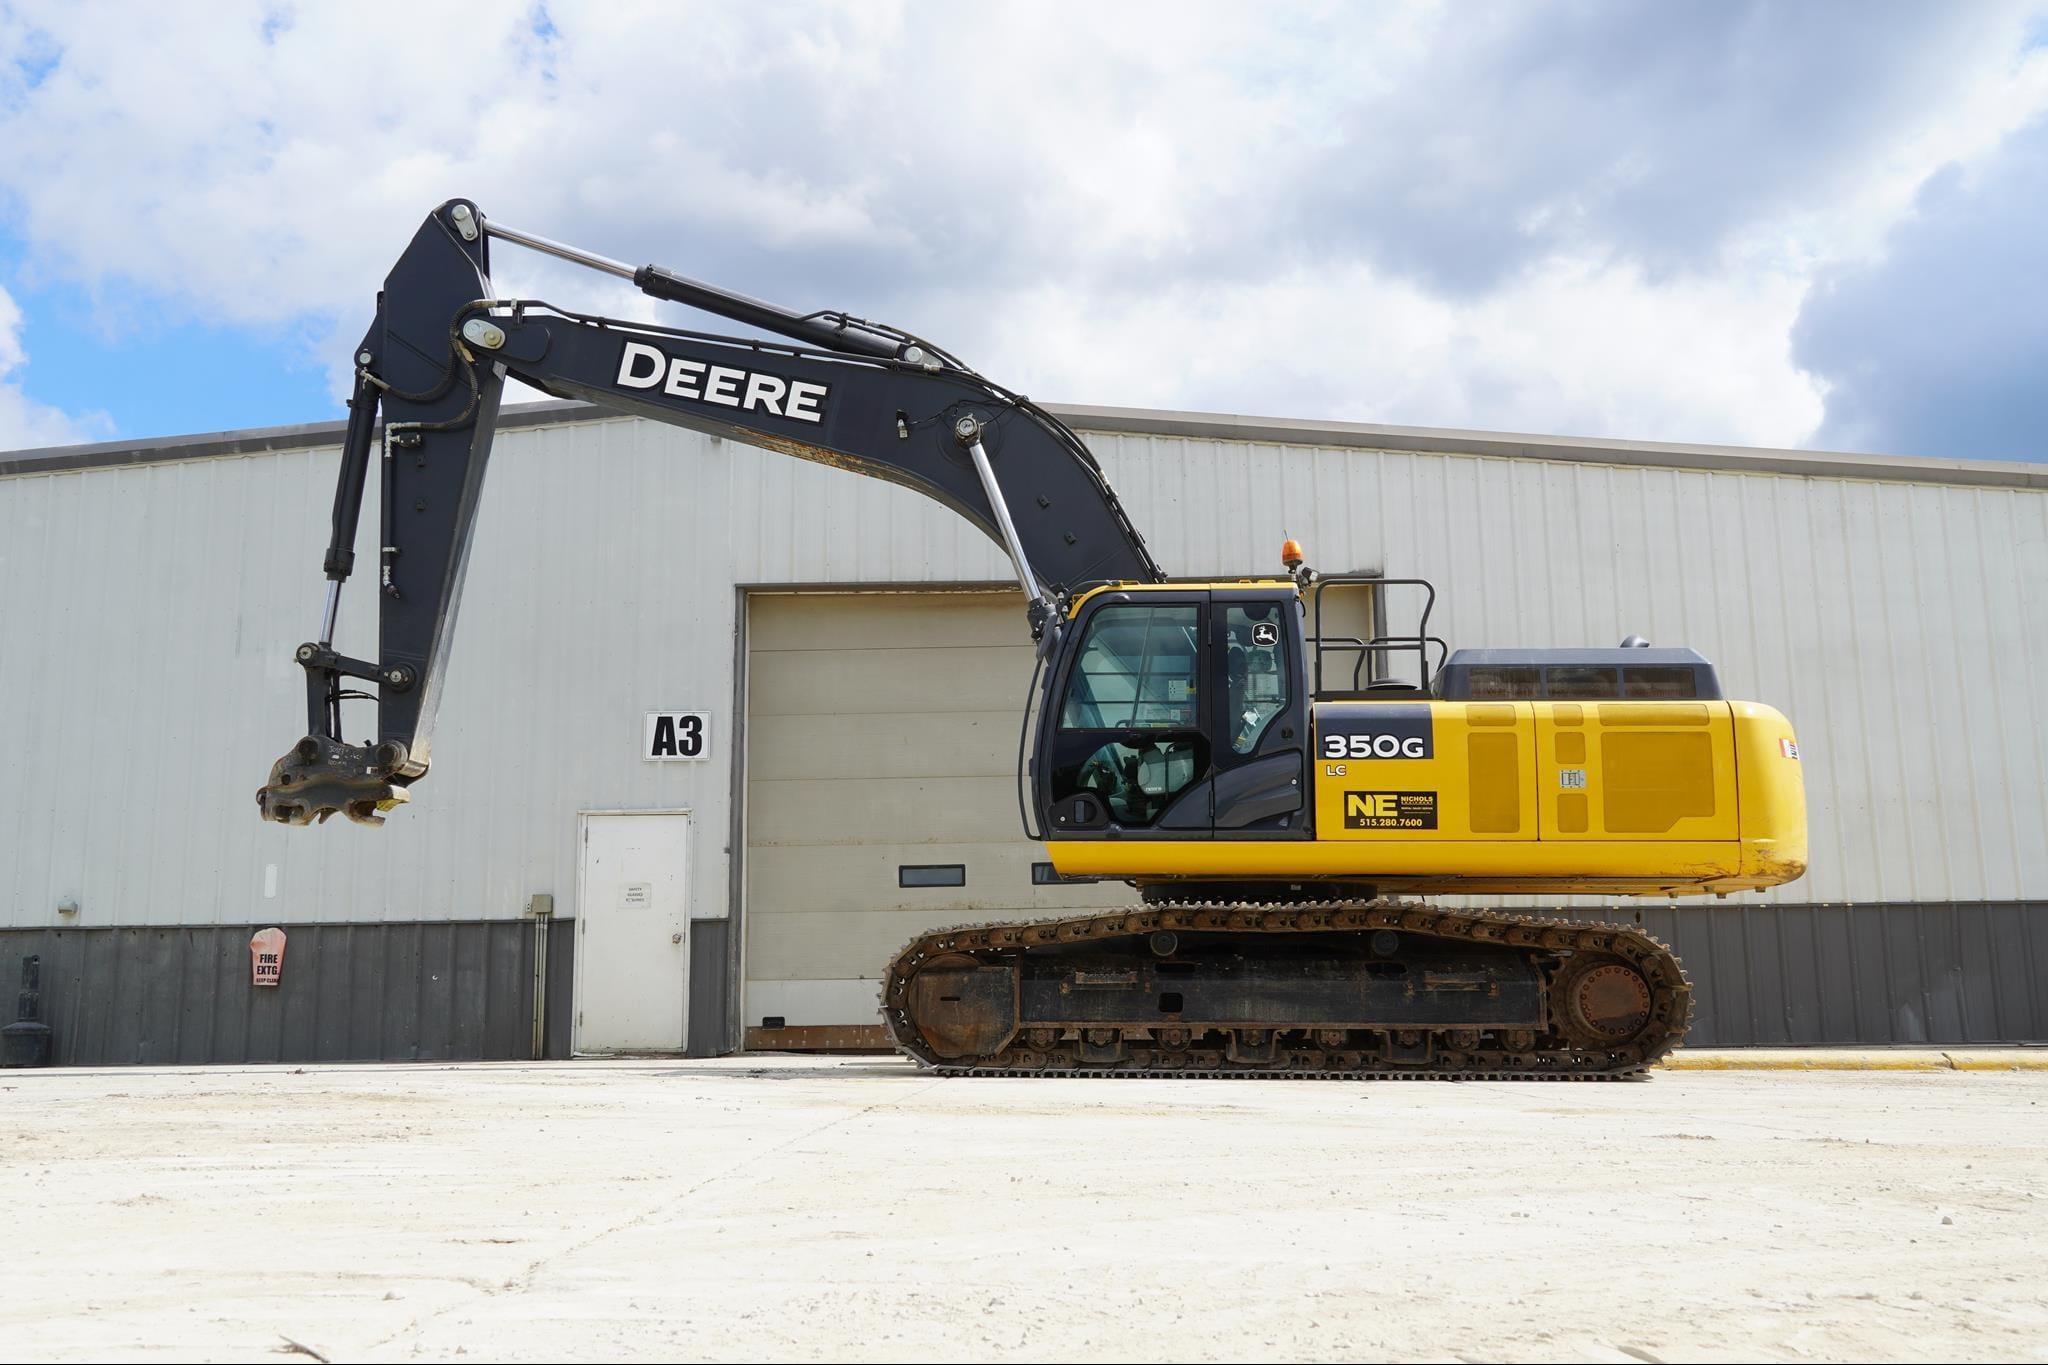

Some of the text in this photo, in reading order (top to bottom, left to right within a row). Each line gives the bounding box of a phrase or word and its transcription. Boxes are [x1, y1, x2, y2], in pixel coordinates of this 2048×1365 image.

[617, 341, 827, 423] DEERE
[651, 716, 702, 756] A3
[1325, 735, 1424, 758] 350G
[1326, 766, 1346, 776] LC
[1348, 795, 1398, 817] NE
[1359, 818, 1423, 827] 515.280.7600
[259, 954, 278, 963] FIRE
[257, 966, 280, 975] EXTG.
